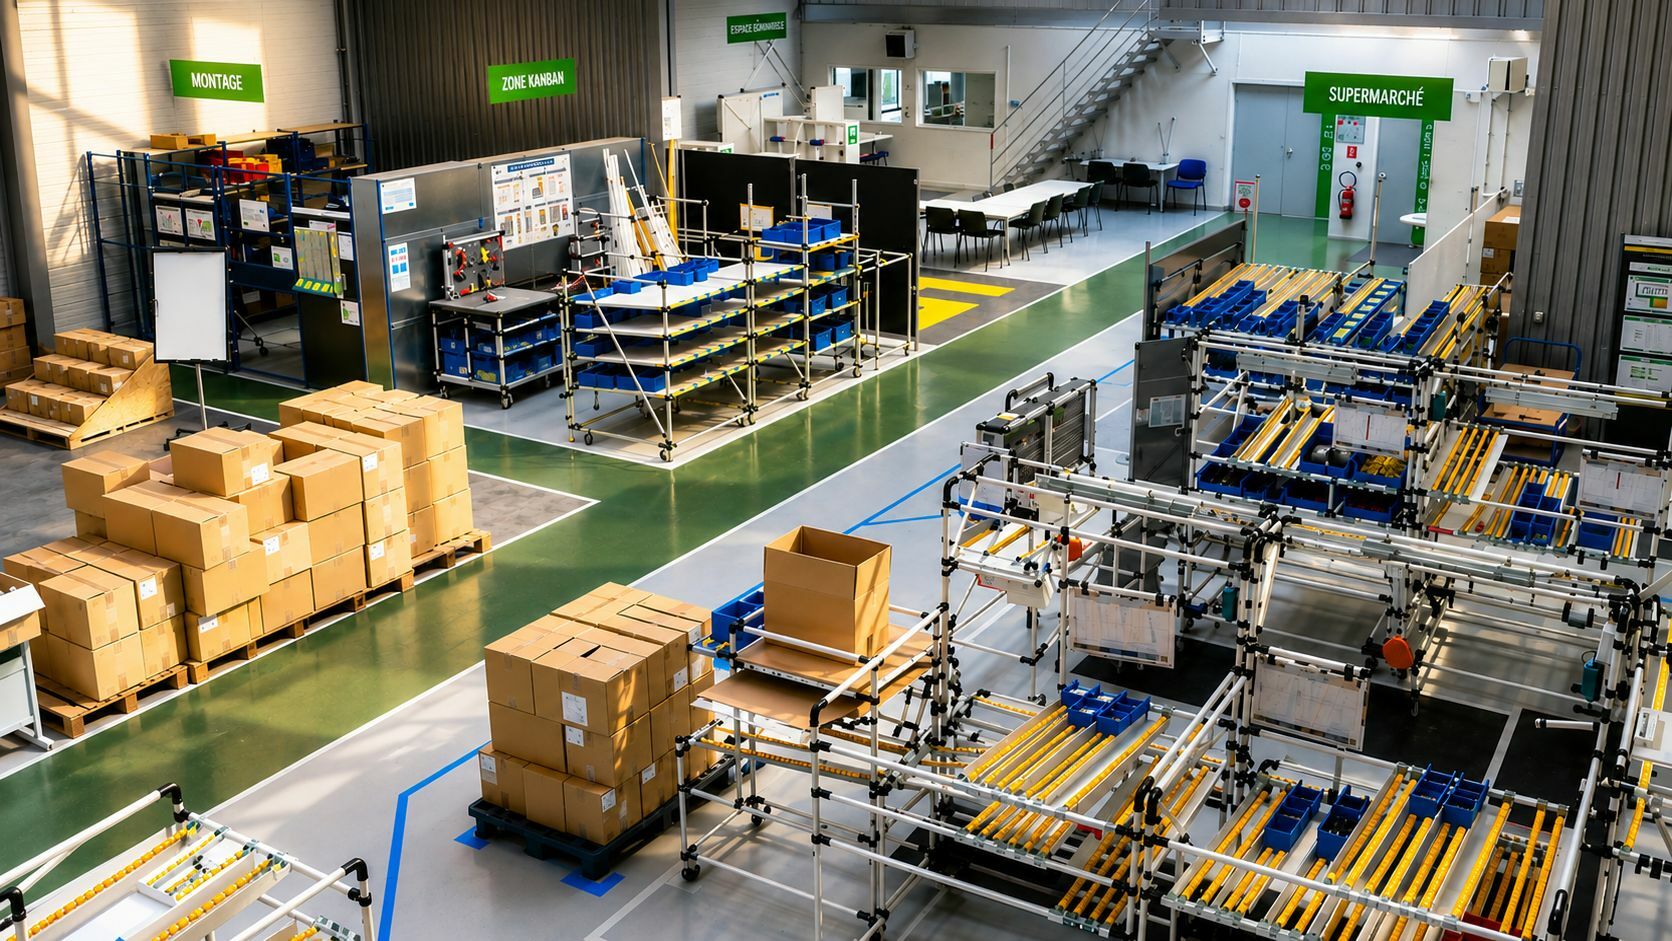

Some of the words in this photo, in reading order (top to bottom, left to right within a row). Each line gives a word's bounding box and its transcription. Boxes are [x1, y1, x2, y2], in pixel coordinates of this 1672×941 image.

[191, 72, 243, 91] MONTAGE
[502, 75, 526, 91] ZONE
[528, 71, 564, 88] KANBAN
[1329, 86, 1424, 106] SUPERMARCHÉ
